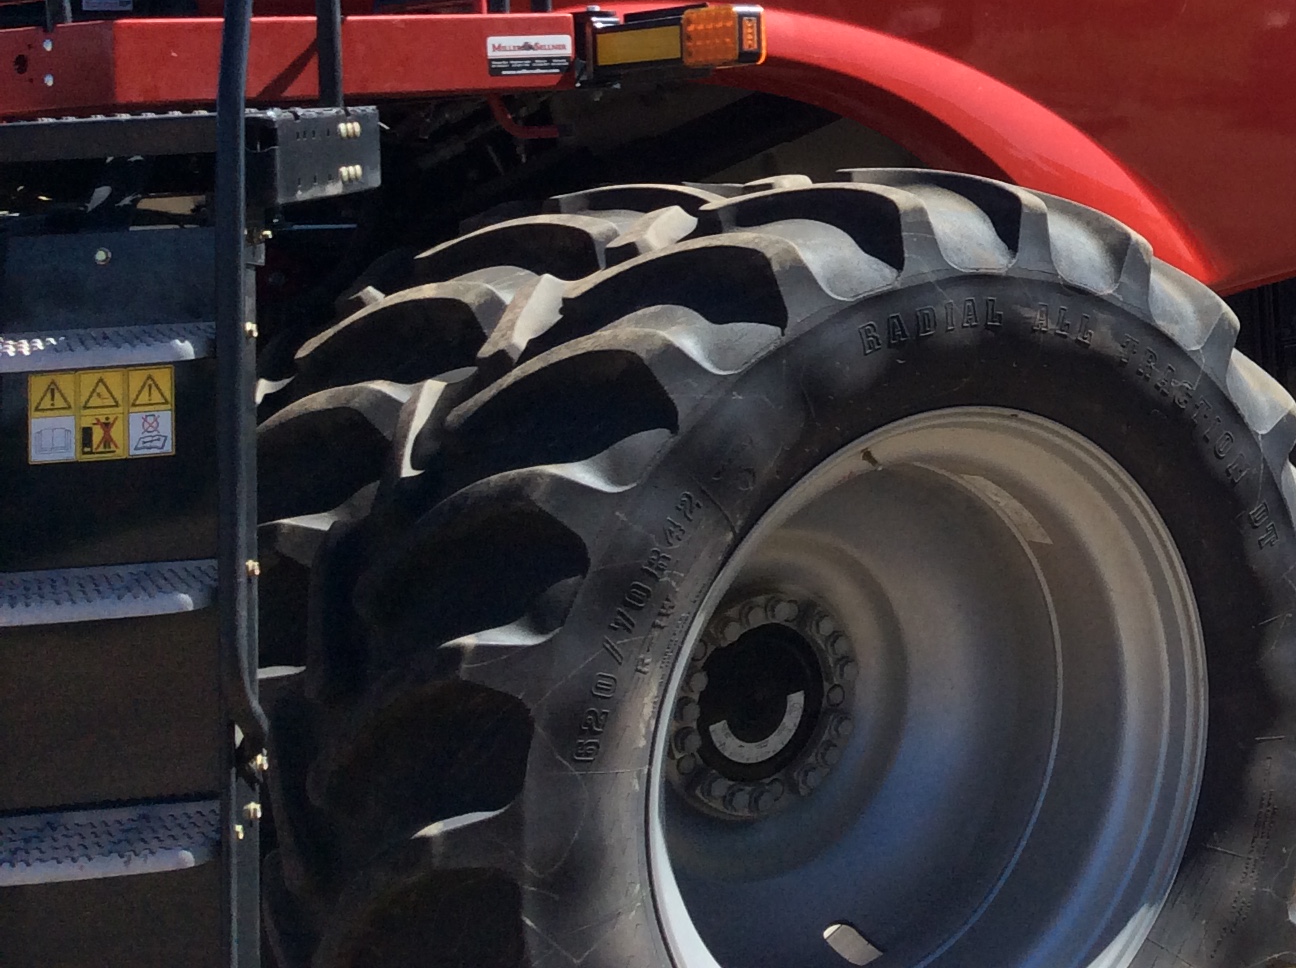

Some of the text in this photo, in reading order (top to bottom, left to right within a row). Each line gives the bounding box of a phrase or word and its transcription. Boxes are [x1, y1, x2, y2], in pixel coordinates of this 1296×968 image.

[858, 296, 1280, 550] RADIAL ALL TRACTION DT
[573, 490, 703, 763] 620/70R42
